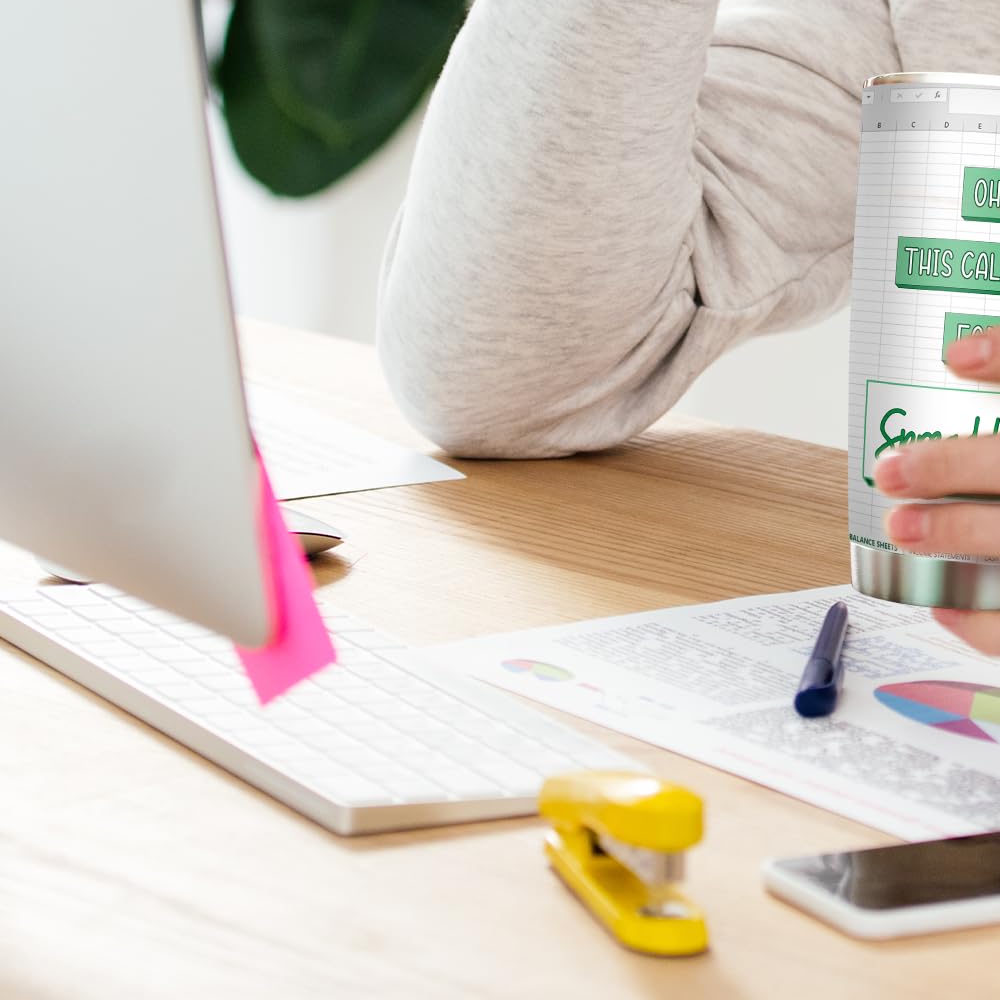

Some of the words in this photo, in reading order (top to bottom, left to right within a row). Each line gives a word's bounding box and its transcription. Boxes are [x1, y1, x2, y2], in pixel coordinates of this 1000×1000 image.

[905, 247, 953, 278] THIS
[849, 533, 875, 547] BALANCE
[876, 540, 898, 552] SHEETS
